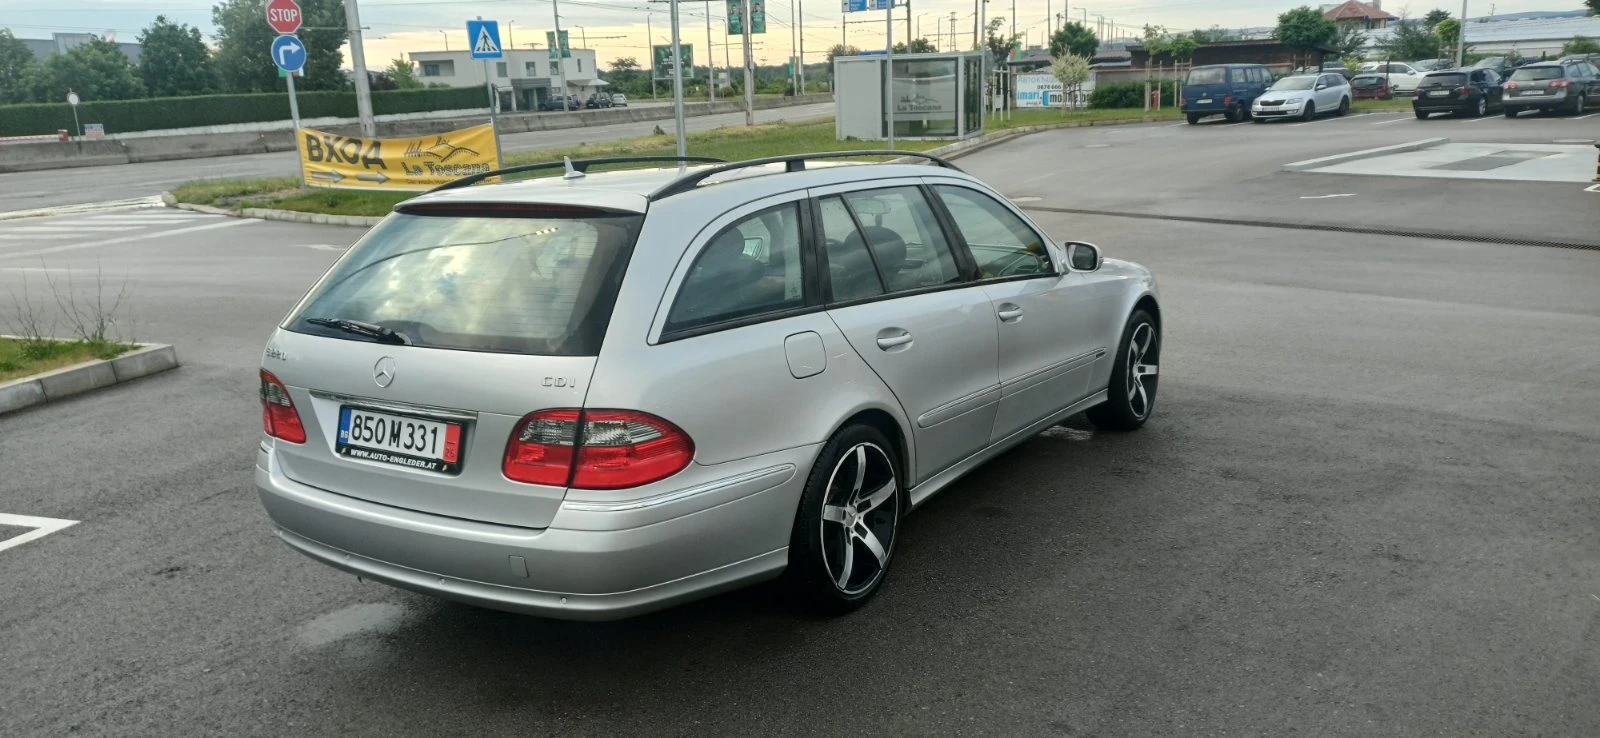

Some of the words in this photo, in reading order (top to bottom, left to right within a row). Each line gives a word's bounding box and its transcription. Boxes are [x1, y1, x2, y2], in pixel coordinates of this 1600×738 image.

[270, 8, 298, 22] STOP
[305, 134, 388, 170] ВХОД
[401, 161, 423, 176] La
[423, 161, 490, 176] Toscana
[541, 376, 576, 388] CDI
[350, 449, 437, 470] WWW.AUTO-ENGLEDER.AT
